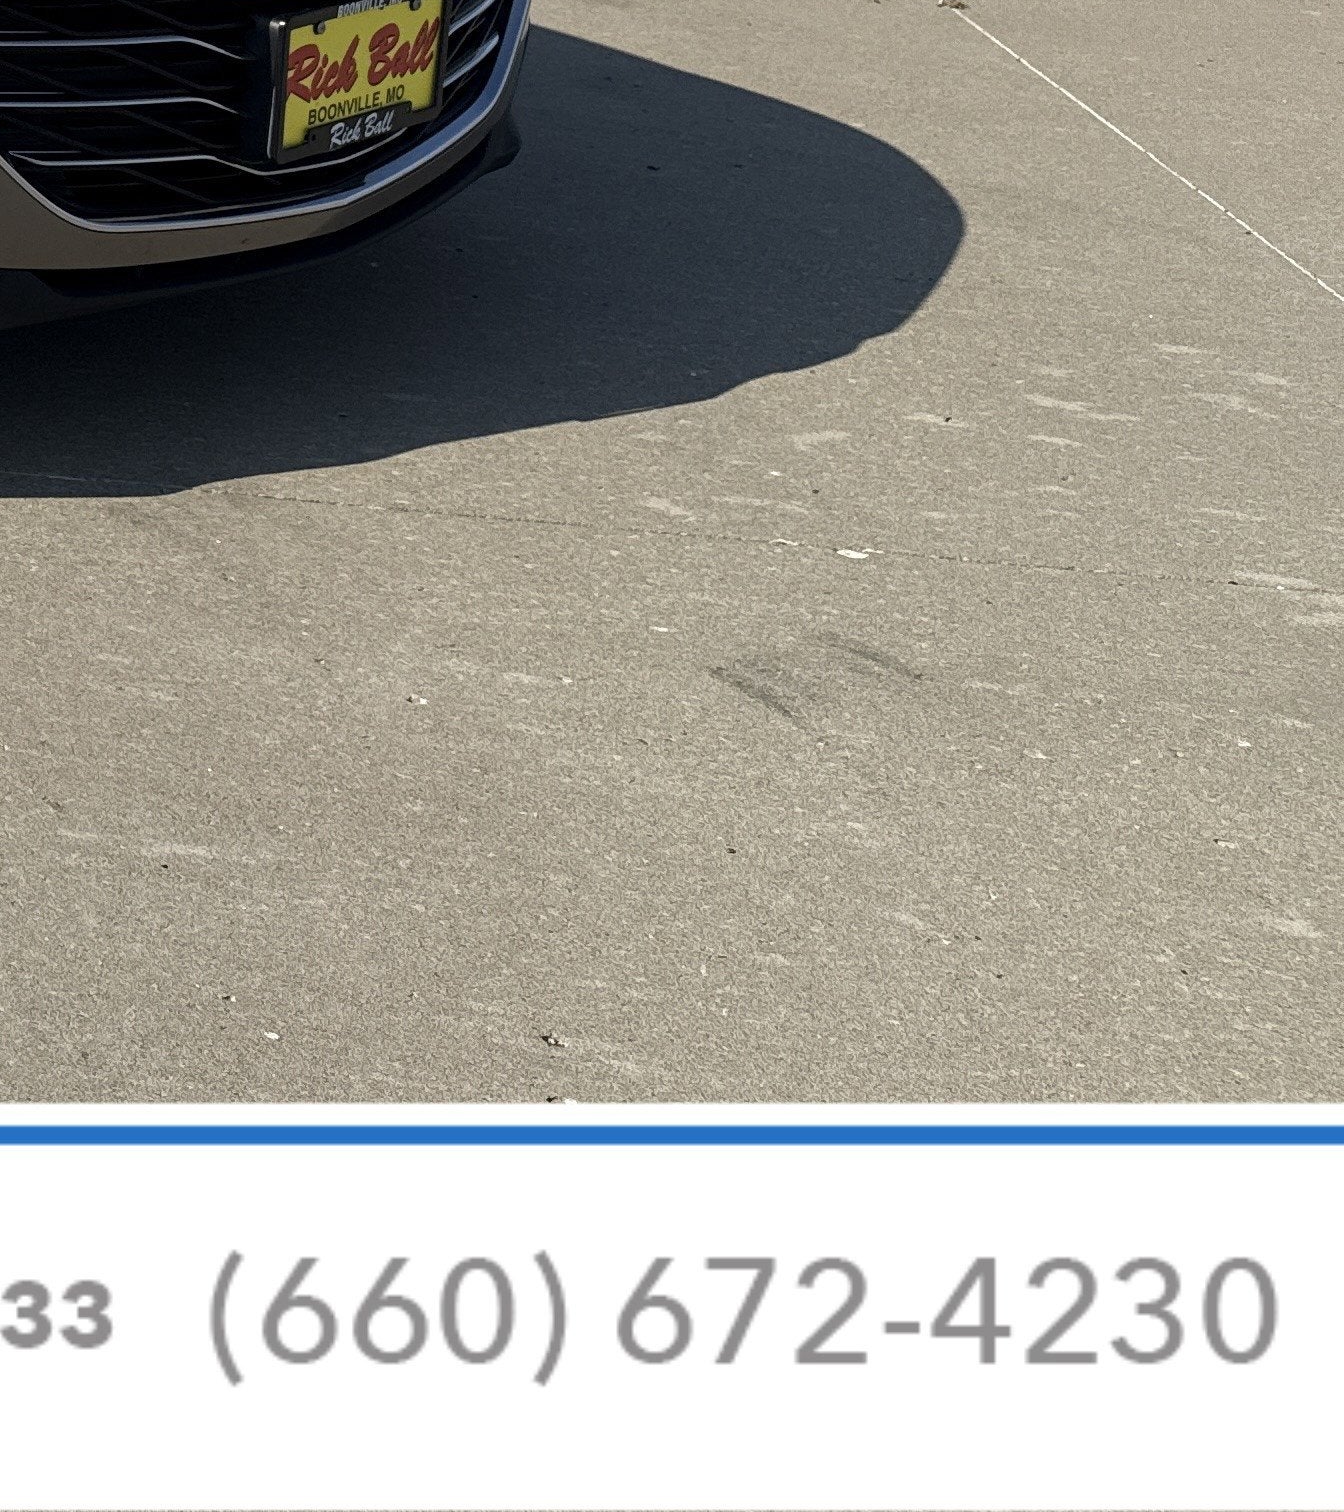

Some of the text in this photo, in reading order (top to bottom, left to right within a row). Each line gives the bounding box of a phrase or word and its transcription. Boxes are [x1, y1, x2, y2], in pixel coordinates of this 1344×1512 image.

[286, 16, 441, 104] Rick Ball
[308, 84, 405, 126] BOONVILLE, MO
[329, 110, 395, 152] Rick Ball
